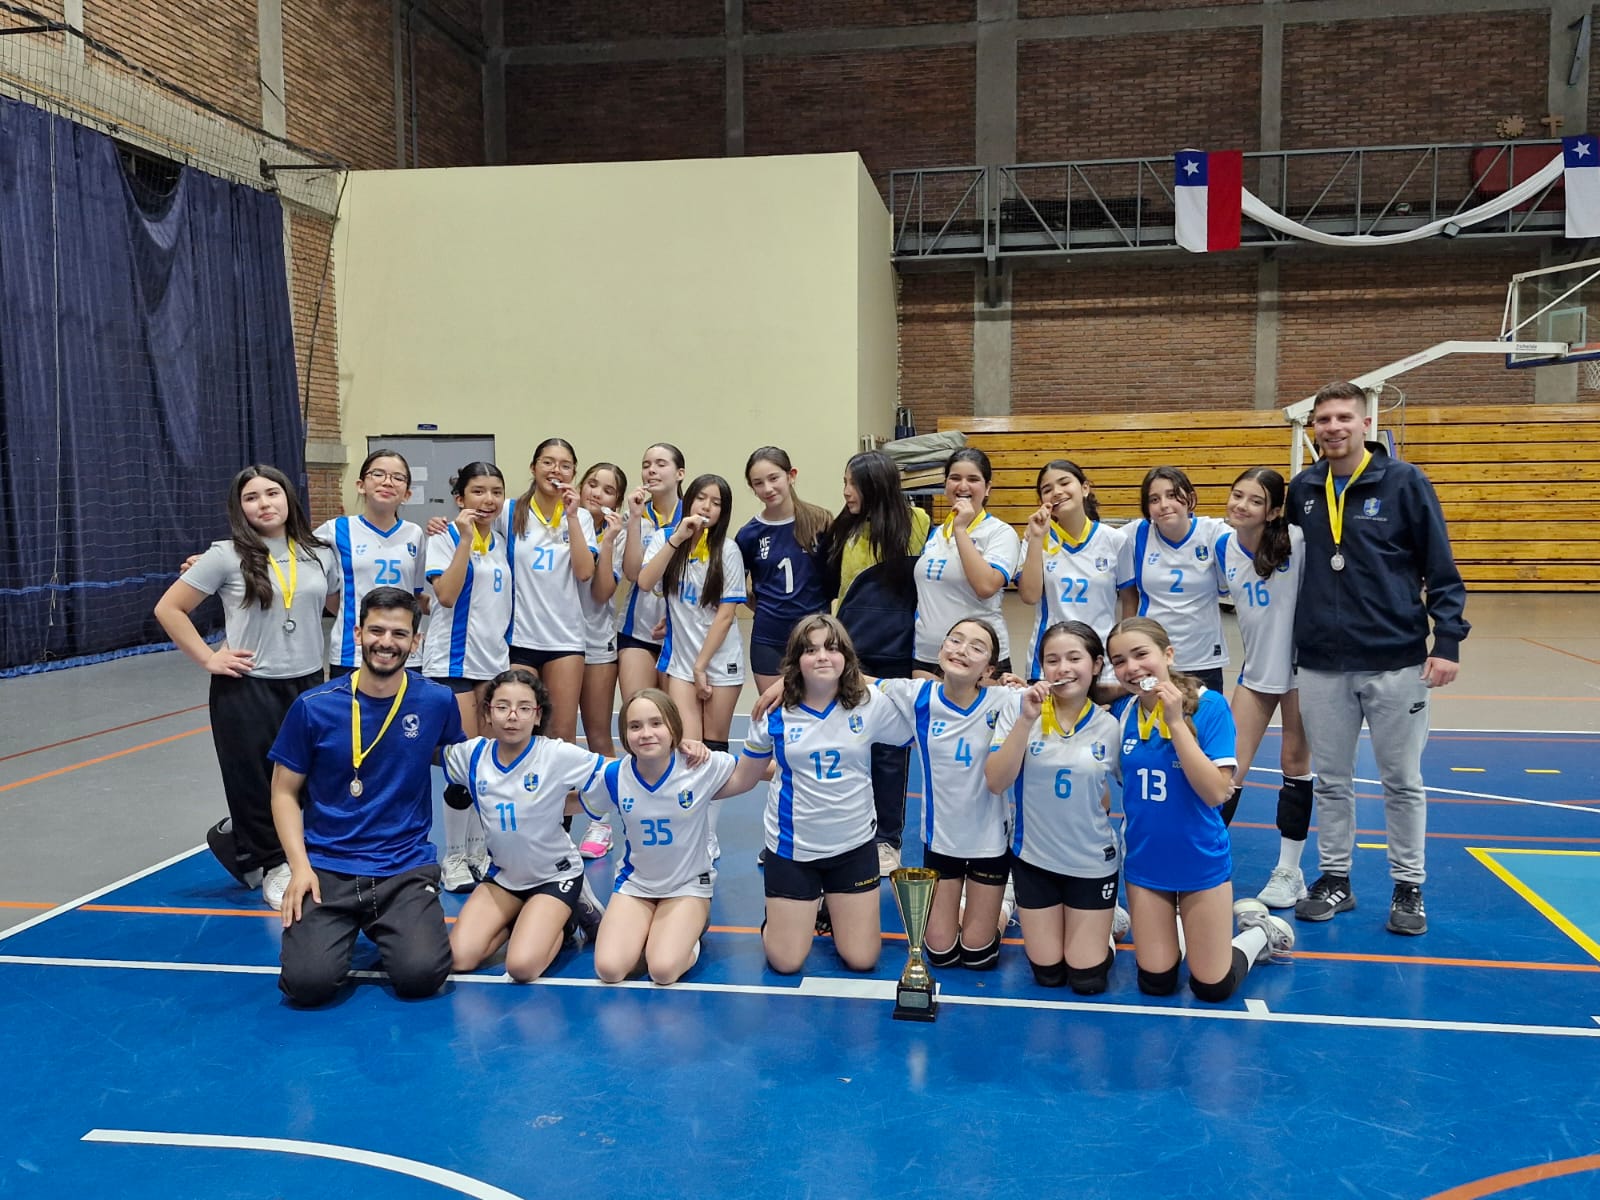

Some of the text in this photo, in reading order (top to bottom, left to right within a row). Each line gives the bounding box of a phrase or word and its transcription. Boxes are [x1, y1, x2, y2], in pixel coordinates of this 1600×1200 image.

[374, 559, 401, 585] 25
[533, 546, 554, 571] 21
[927, 558, 948, 581] 17
[493, 568, 503, 593] 8
[777, 557, 794, 594] 1
[1169, 569, 1184, 593] 2
[1060, 577, 1089, 603] 22
[1242, 580, 1270, 607] 16
[809, 750, 842, 780] 12
[954, 737, 973, 768] 4
[1054, 768, 1072, 799] 6
[1136, 768, 1167, 802] 13
[495, 802, 517, 832] 11
[639, 818, 673, 846] 35
